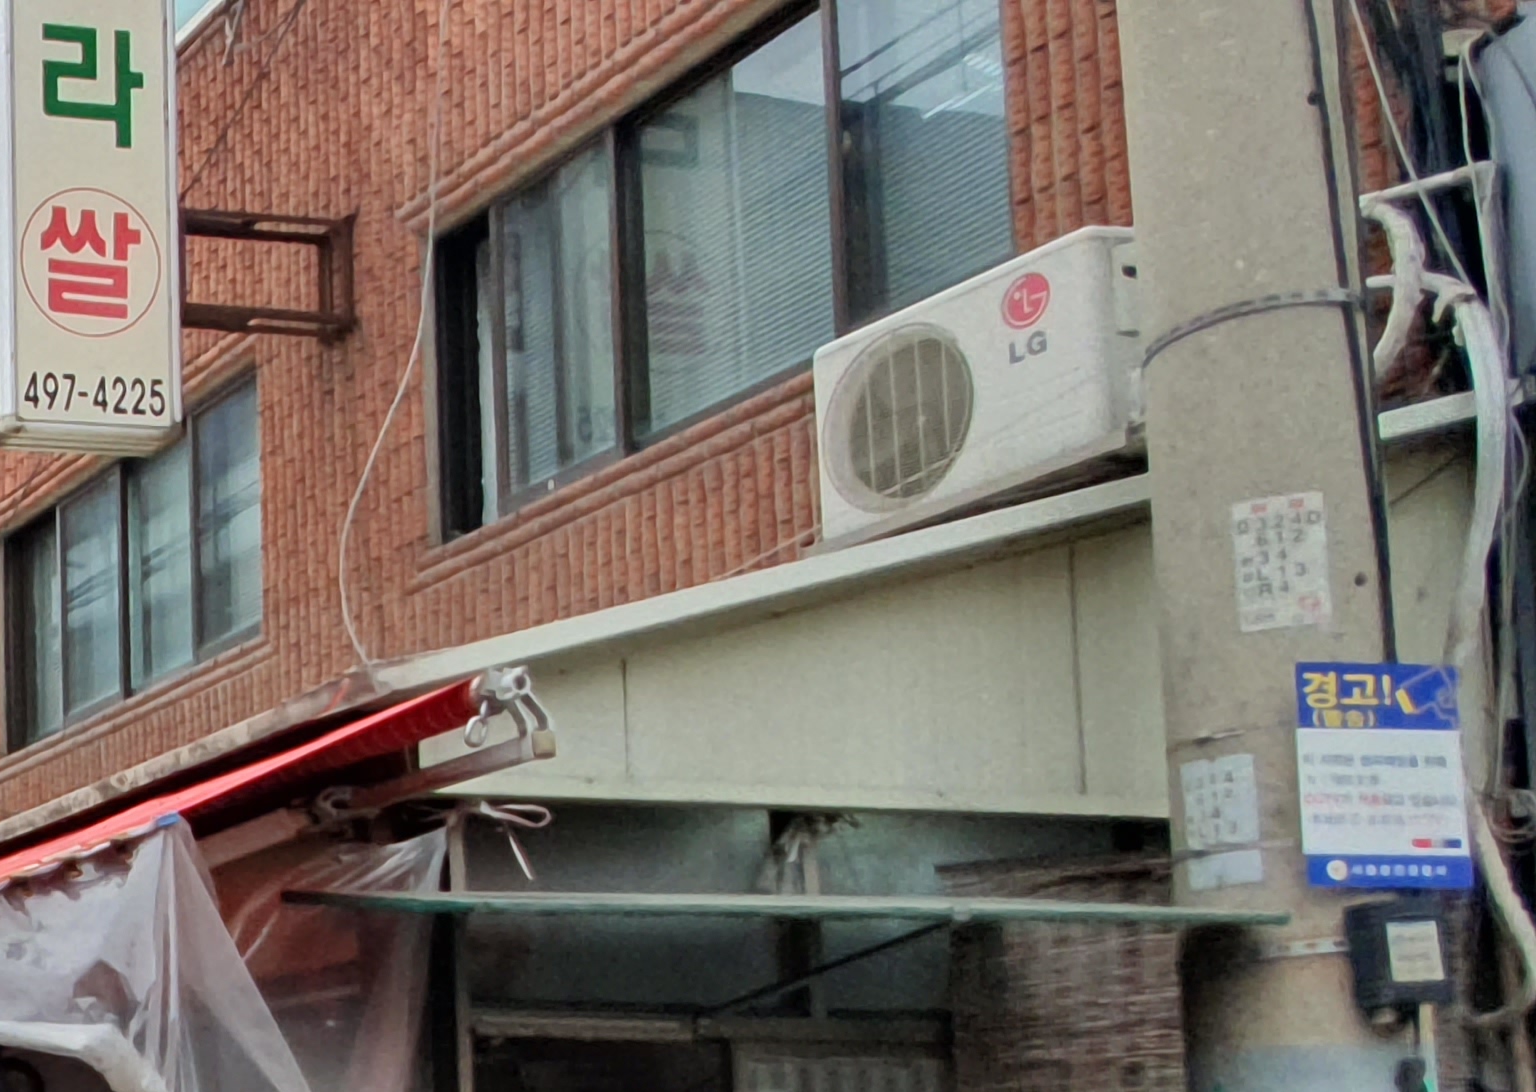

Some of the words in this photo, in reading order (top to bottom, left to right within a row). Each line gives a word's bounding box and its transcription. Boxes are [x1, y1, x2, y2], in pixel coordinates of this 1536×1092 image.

[41, 22, 144, 149] 라
[40, 204, 142, 320] 쌀
[1008, 331, 1048, 364] LG
[23, 370, 166, 417] 497-4225
[1302, 670, 1391, 709] 경고!
